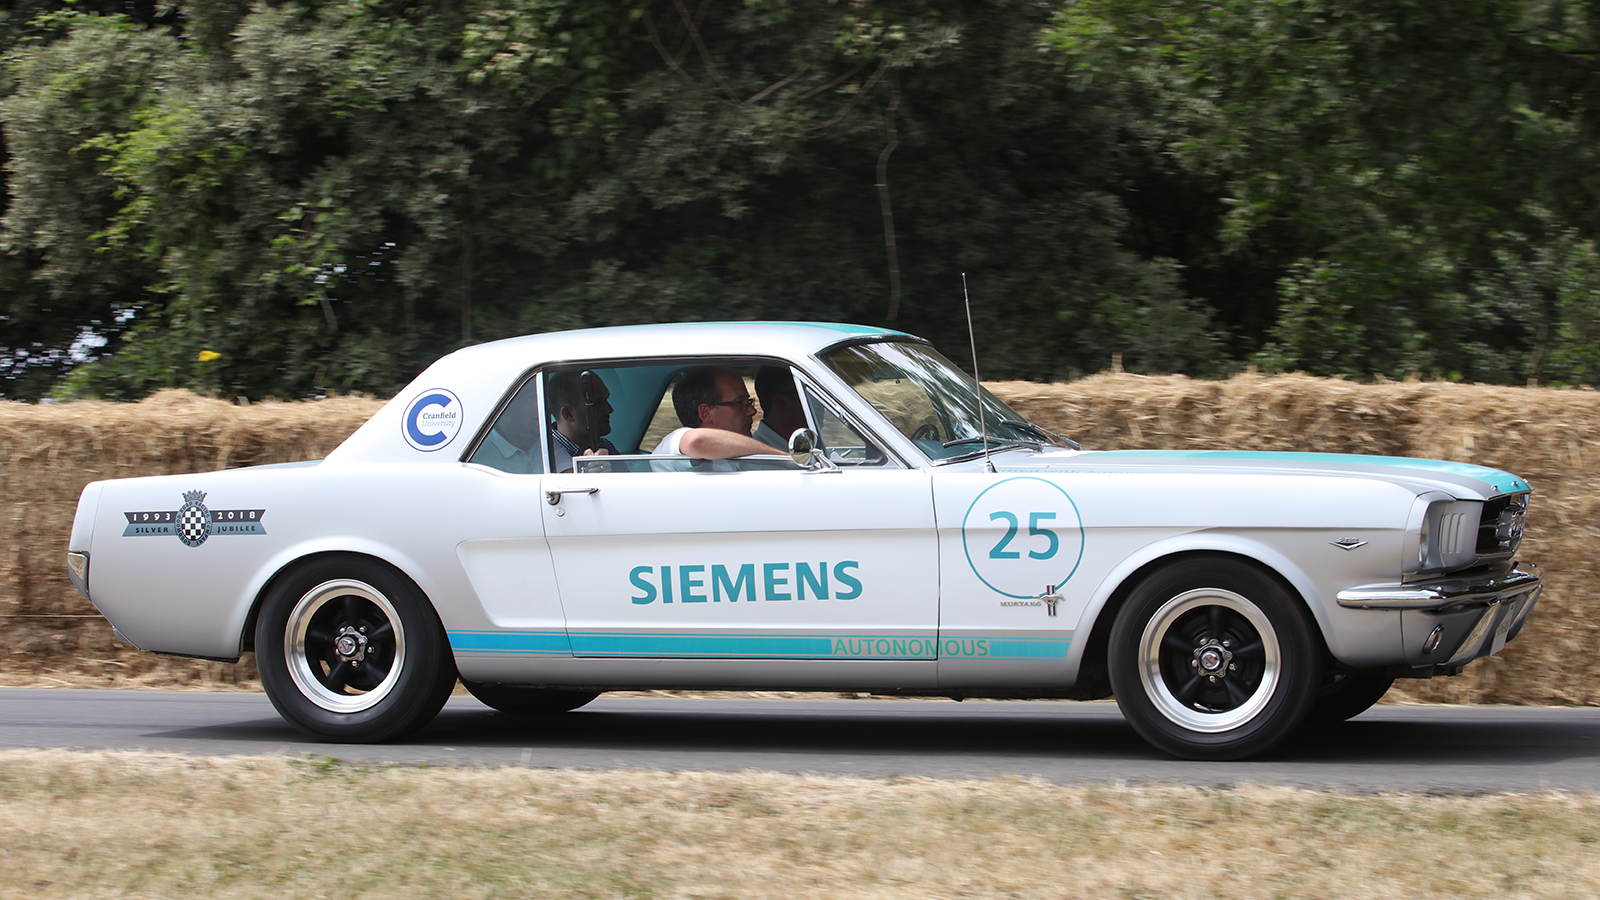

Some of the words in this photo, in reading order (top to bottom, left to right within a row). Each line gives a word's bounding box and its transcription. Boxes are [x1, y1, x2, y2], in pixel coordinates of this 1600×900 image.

[133, 513, 171, 521] 1993
[217, 511, 256, 520] 2018
[217, 525, 256, 533] JUBILEE
[989, 511, 1059, 560] 25
[629, 560, 863, 605] SIEMENS
[833, 638, 989, 657] AUTONOMOUS
